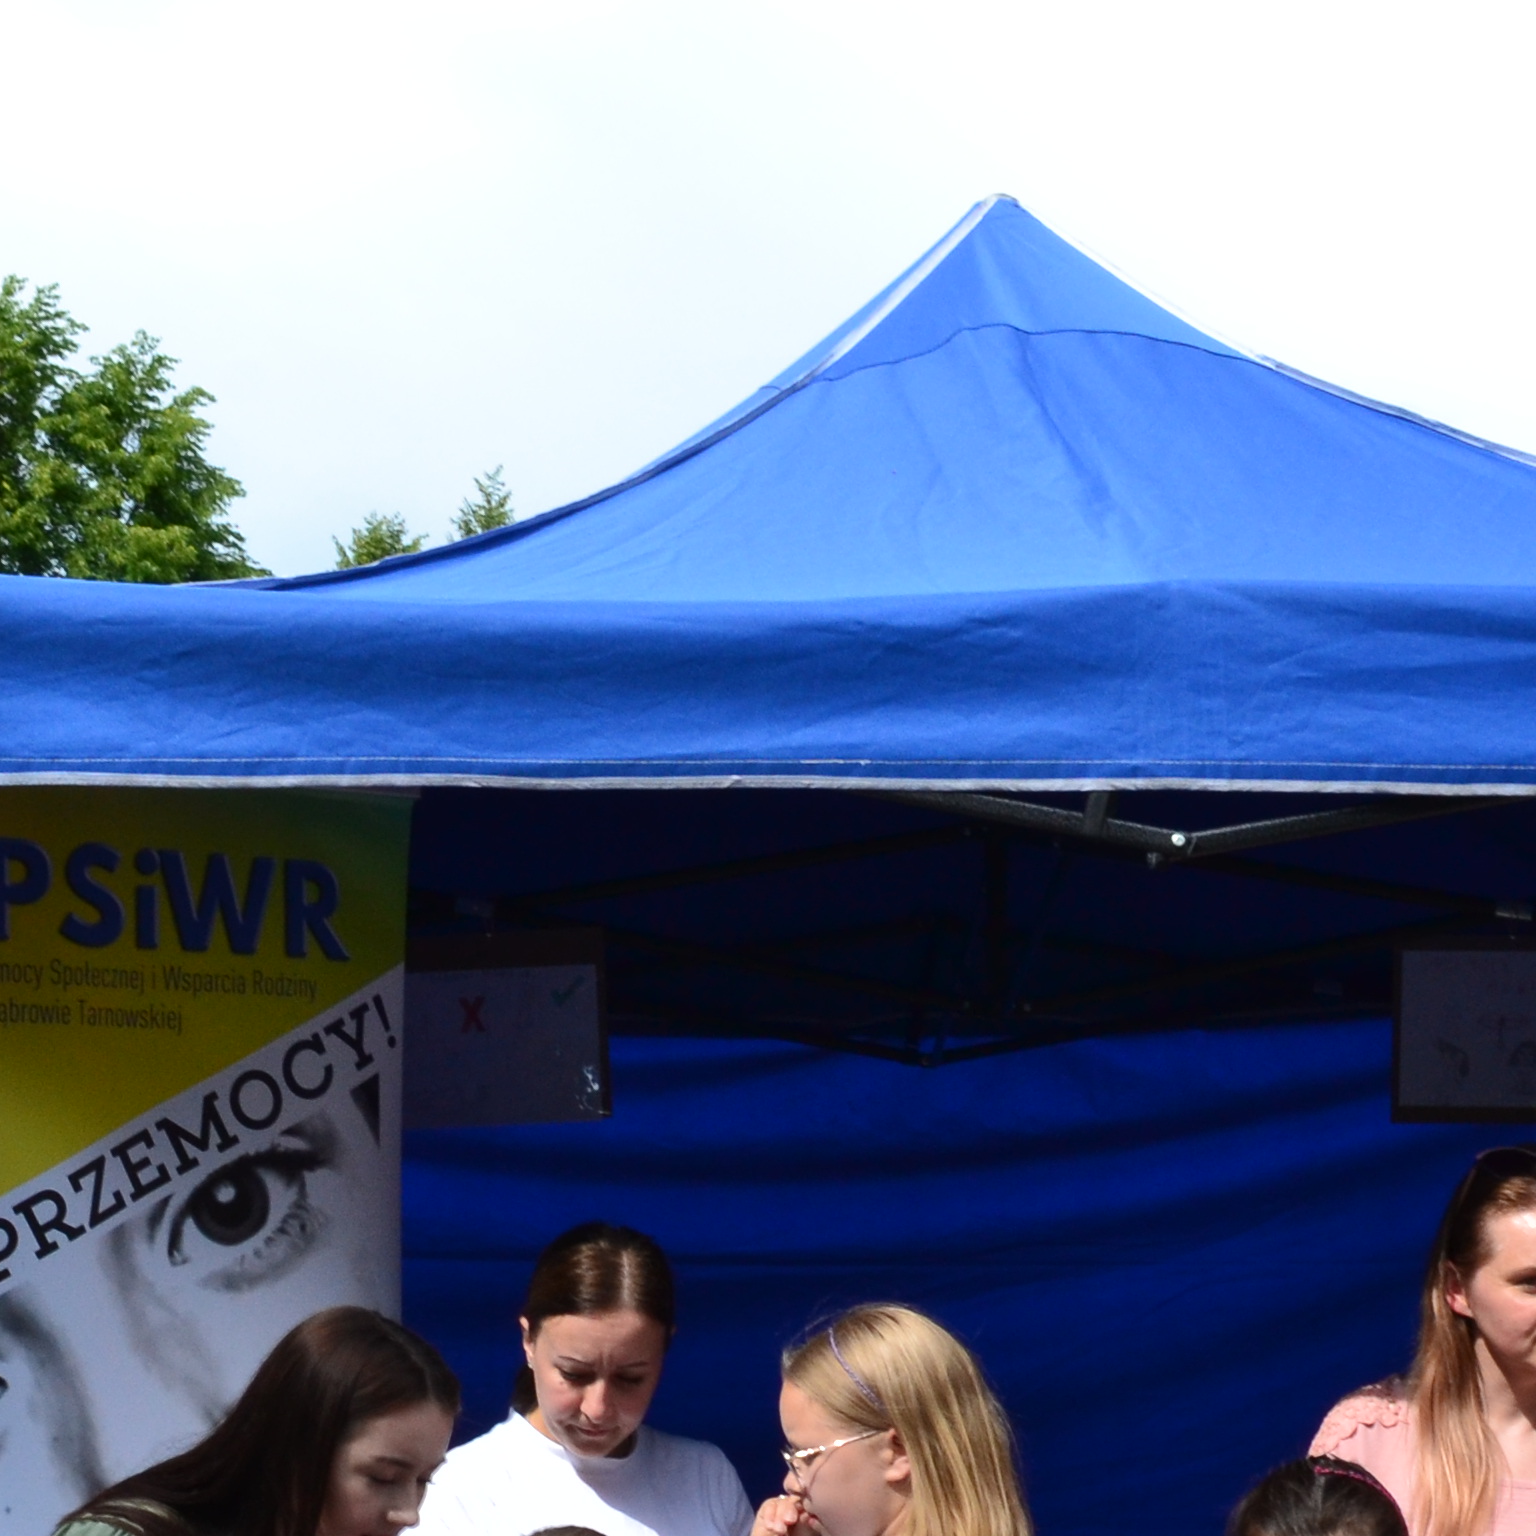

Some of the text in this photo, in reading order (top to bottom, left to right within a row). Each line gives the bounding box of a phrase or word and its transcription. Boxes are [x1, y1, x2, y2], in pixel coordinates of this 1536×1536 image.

[50, 958, 146, 996] Społecznej
[164, 966, 246, 997] Wsparcia
[252, 970, 319, 1001] Rodziny
[78, 1000, 183, 1035] Tarnowskiej
